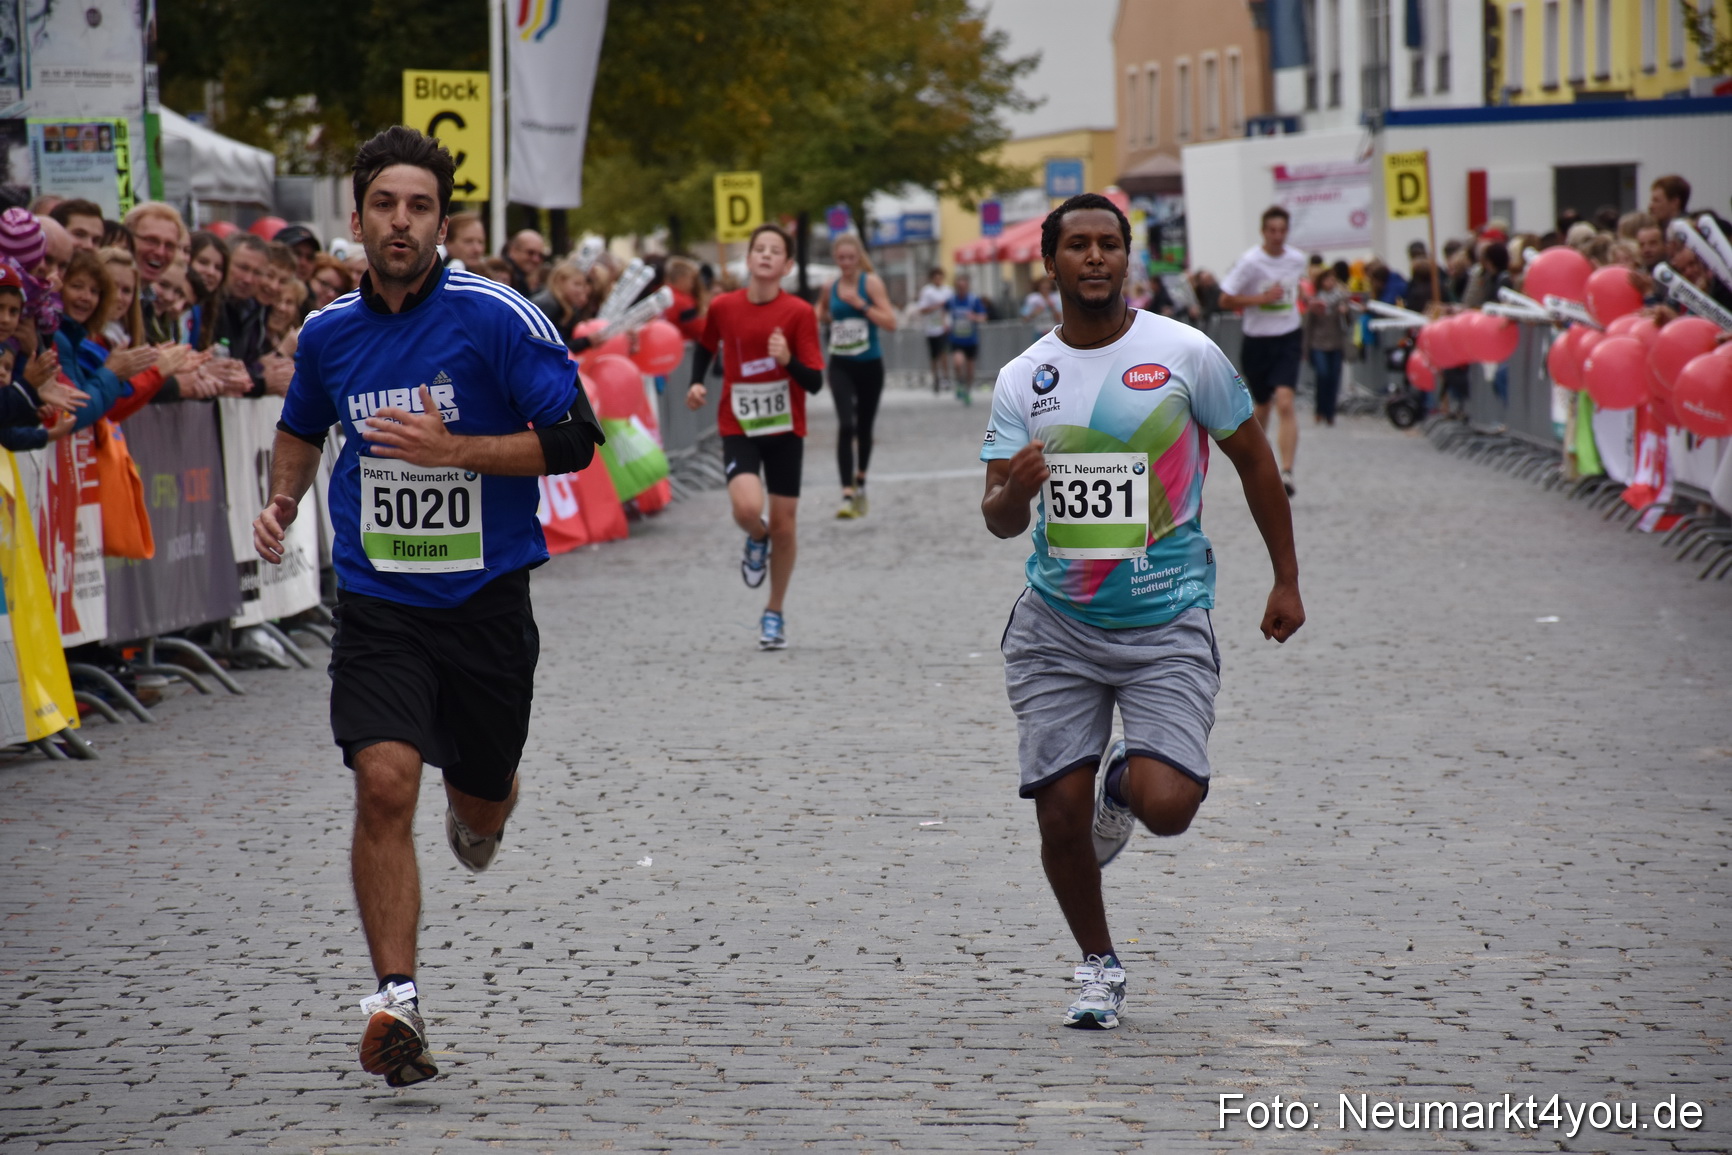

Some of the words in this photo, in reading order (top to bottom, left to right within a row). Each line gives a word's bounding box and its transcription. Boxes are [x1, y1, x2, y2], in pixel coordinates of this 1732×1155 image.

[415, 77, 479, 101] Block
[427, 110, 466, 170] C
[1397, 171, 1421, 204] D
[728, 194, 751, 228] D
[1129, 371, 1165, 383] Hervis
[347, 384, 457, 420] HUBER
[739, 394, 785, 416] 5118
[1031, 405, 1061, 418] Neumarkt
[363, 468, 398, 481] PARTL
[401, 471, 459, 482] Neumarkt
[1046, 465, 1071, 474] ARTL
[1075, 464, 1128, 474] Neumarkt
[374, 487, 470, 529] 5020
[1050, 480, 1133, 518] 5331
[365, 523, 371, 531] S
[393, 540, 448, 557] Florian
[1130, 556, 1153, 573] 16.
[1130, 565, 1182, 585] Neumarkter
[1131, 579, 1173, 597] Stadtlauf
